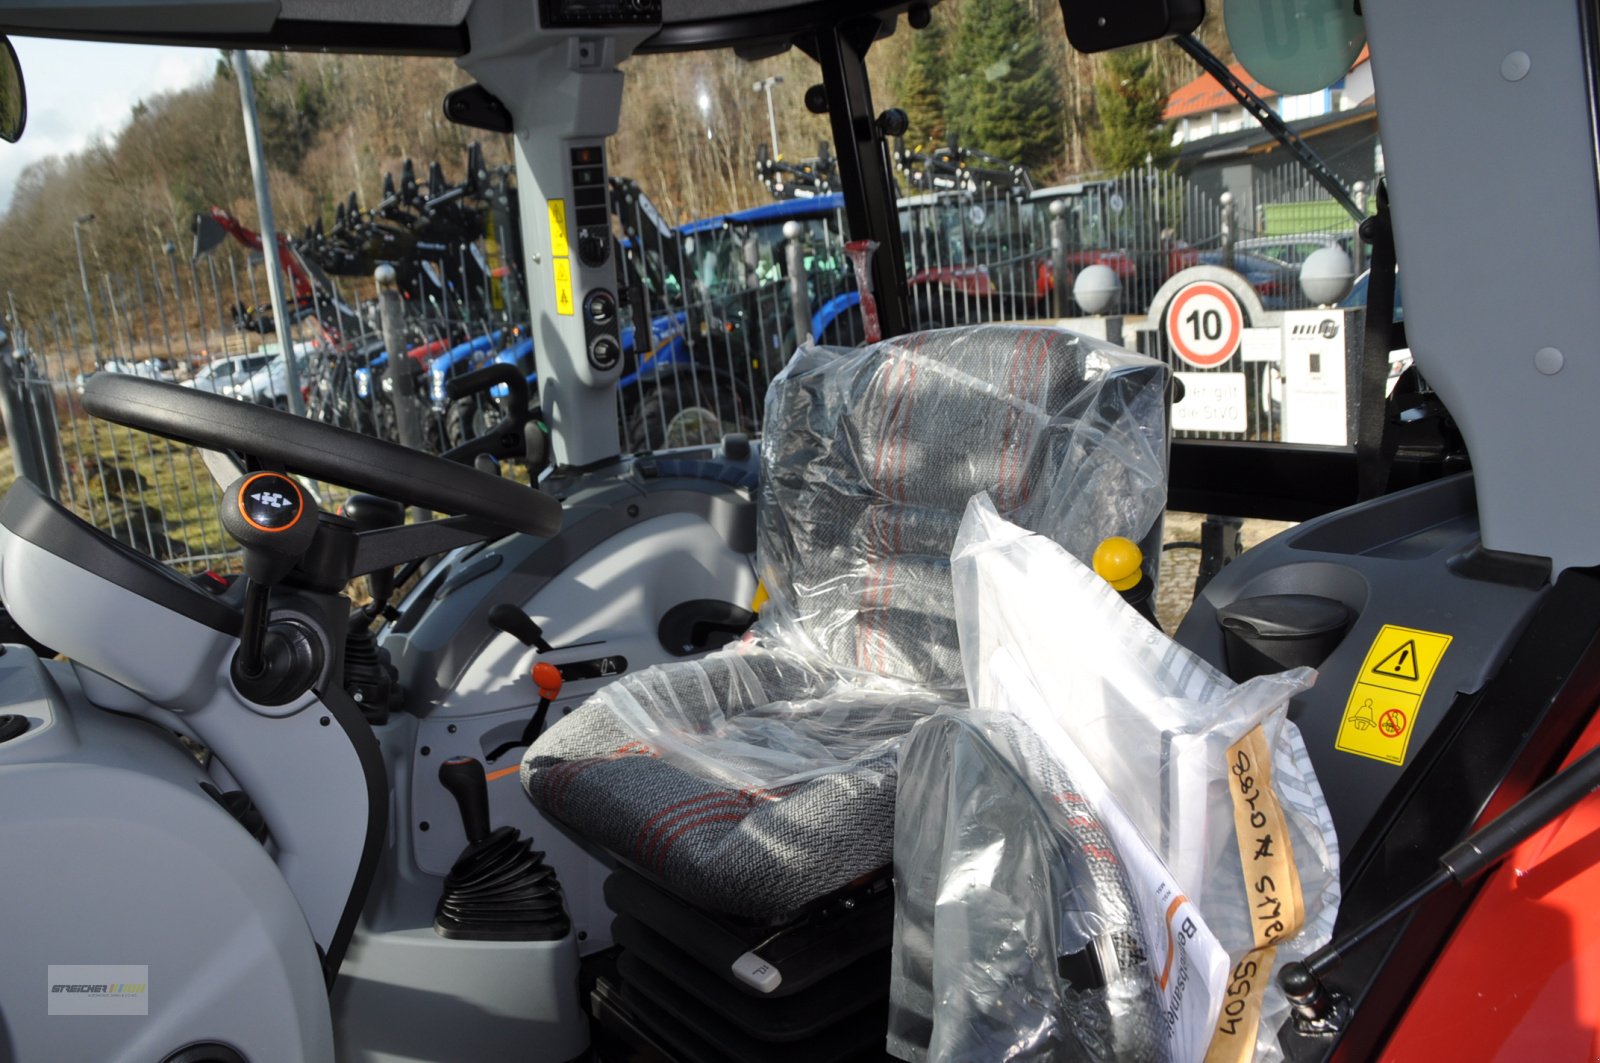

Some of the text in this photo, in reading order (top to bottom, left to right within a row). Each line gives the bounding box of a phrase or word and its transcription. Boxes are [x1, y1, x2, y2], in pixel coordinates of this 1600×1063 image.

[1186, 310, 1222, 341] 10
[1214, 385, 1238, 402] gilt
[1203, 404, 1239, 421] StVO
